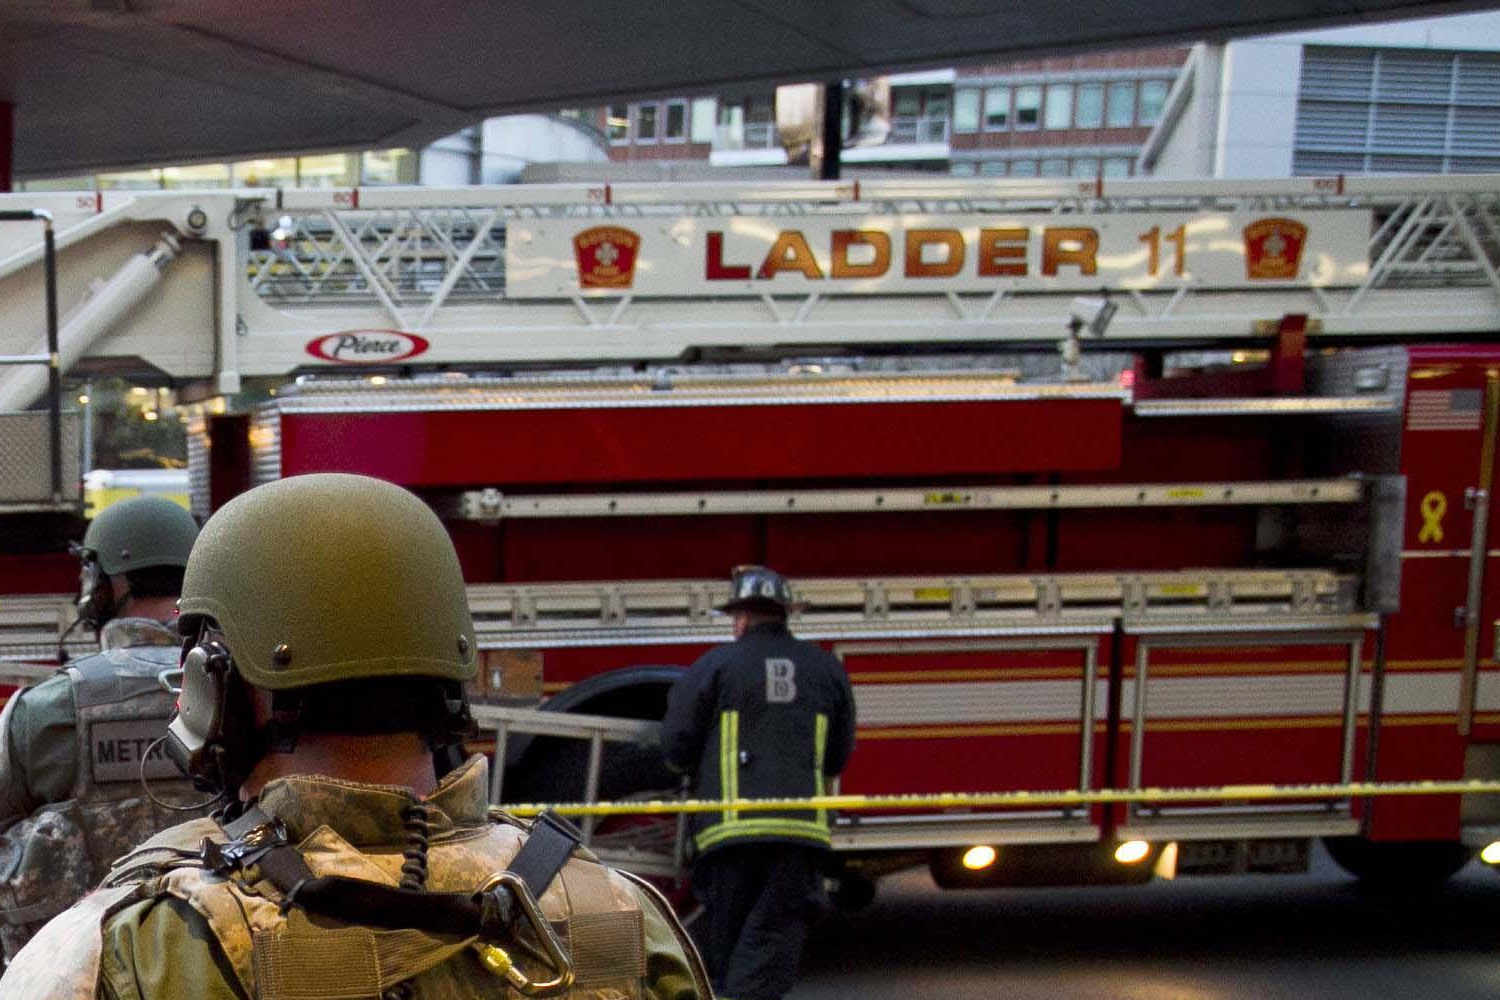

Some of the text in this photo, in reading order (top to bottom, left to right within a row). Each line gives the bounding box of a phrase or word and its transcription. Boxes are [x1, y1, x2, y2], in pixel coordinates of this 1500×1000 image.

[705, 227, 1099, 280] LADDER
[1138, 225, 1188, 277] 11
[333, 334, 400, 359] Pierce
[98, 736, 164, 763] METR
